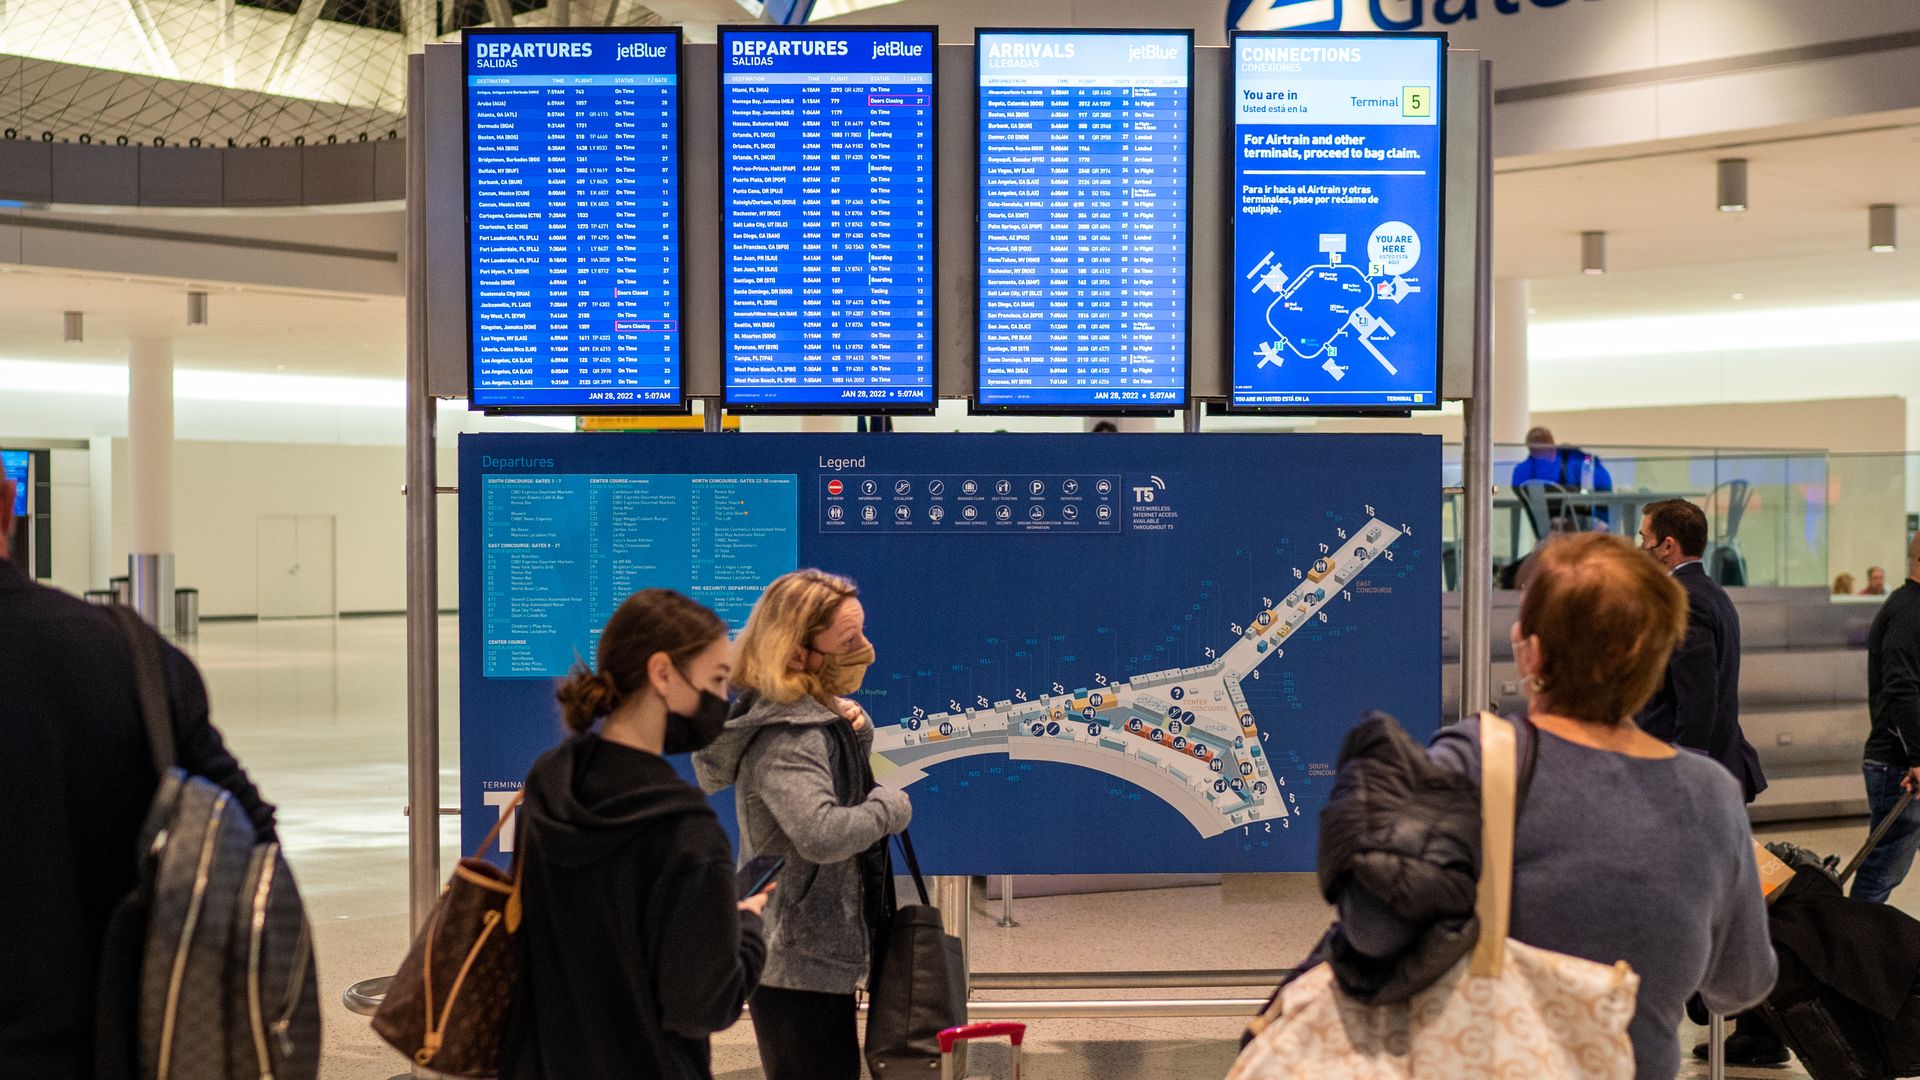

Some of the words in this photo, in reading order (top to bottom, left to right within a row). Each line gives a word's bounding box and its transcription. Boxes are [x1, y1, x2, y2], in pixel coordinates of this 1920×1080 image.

[477, 43, 592, 57] DEPARTURES
[617, 43, 666, 61] jetBlue
[732, 41, 848, 55] DEPARTURES
[872, 41, 922, 59] jetBlue
[989, 43, 1075, 58] ARRIVALS
[1128, 44, 1177, 61] jetBlue
[1242, 48, 1361, 62] CONNECTIONS
[477, 59, 518, 67] SALIDAS
[732, 57, 773, 66] SALIDAS
[989, 59, 1039, 68] LLEGADAS
[1242, 64, 1301, 72] CONEXIONES
[1243, 90, 1263, 100] You
[1266, 92, 1285, 100] are
[1288, 90, 1297, 100] in
[1351, 97, 1399, 107] Terminal
[1412, 95, 1420, 109] 5
[1243, 105, 1266, 113] Usted
[1268, 105, 1286, 113] está
[1300, 105, 1307, 113] la
[1245, 135, 1264, 145] For
[1266, 134, 1310, 145] Airtrain
[1312, 135, 1332, 145] and
[1334, 135, 1366, 145] other
[1244, 148, 1302, 160] terminals,
[1304, 148, 1349, 160] proceed
[1351, 149, 1362, 158] to
[1364, 148, 1385, 160] bag
[1387, 148, 1420, 158] claim.
[1243, 186, 1263, 194] Para
[1265, 186, 1271, 194] ir
[1274, 186, 1296, 194] hacia
[1297, 186, 1306, 194] el
[1308, 186, 1340, 194] Airtrain
[1342, 187, 1347, 195] y
[1243, 196, 1292, 205] terminales,
[1293, 197, 1313, 205] pase
[1315, 197, 1330, 205] por
[1332, 196, 1366, 204] reclamo
[1368, 196, 1379, 204] de
[1243, 206, 1281, 215] equipaje.
[1374, 265, 1379, 274] 5
[1111, 392, 1121, 400] 28,
[482, 456, 554, 468] Departures
[819, 456, 866, 471] Legend
[1133, 487, 1154, 502] T5
[1364, 504, 1375, 516] 15
[1337, 528, 1346, 539] 16
[1402, 524, 1412, 536] 14
[1318, 543, 1328, 554] 17
[1384, 550, 1394, 561] 12
[1292, 568, 1302, 579] 18
[1343, 590, 1351, 602] 11
[1262, 597, 1272, 608] 19
[1318, 611, 1328, 623] 10
[1231, 623, 1242, 635] 20
[1205, 648, 1216, 660] 21
[1278, 649, 1284, 658] 9
[1095, 673, 1107, 686] 22
[1254, 670, 1260, 680] 8
[1052, 682, 1064, 695] 23
[1015, 688, 1027, 701] 24
[950, 700, 961, 713] 26
[977, 696, 988, 708] 25
[913, 707, 924, 718] 27
[1264, 732, 1270, 742] 7
[1280, 776, 1285, 786] 6
[1289, 793, 1295, 803] 5
[1294, 806, 1300, 816] 4
[1265, 823, 1271, 832] 2
[1283, 819, 1289, 828] 3
[1244, 826, 1248, 836] 1
